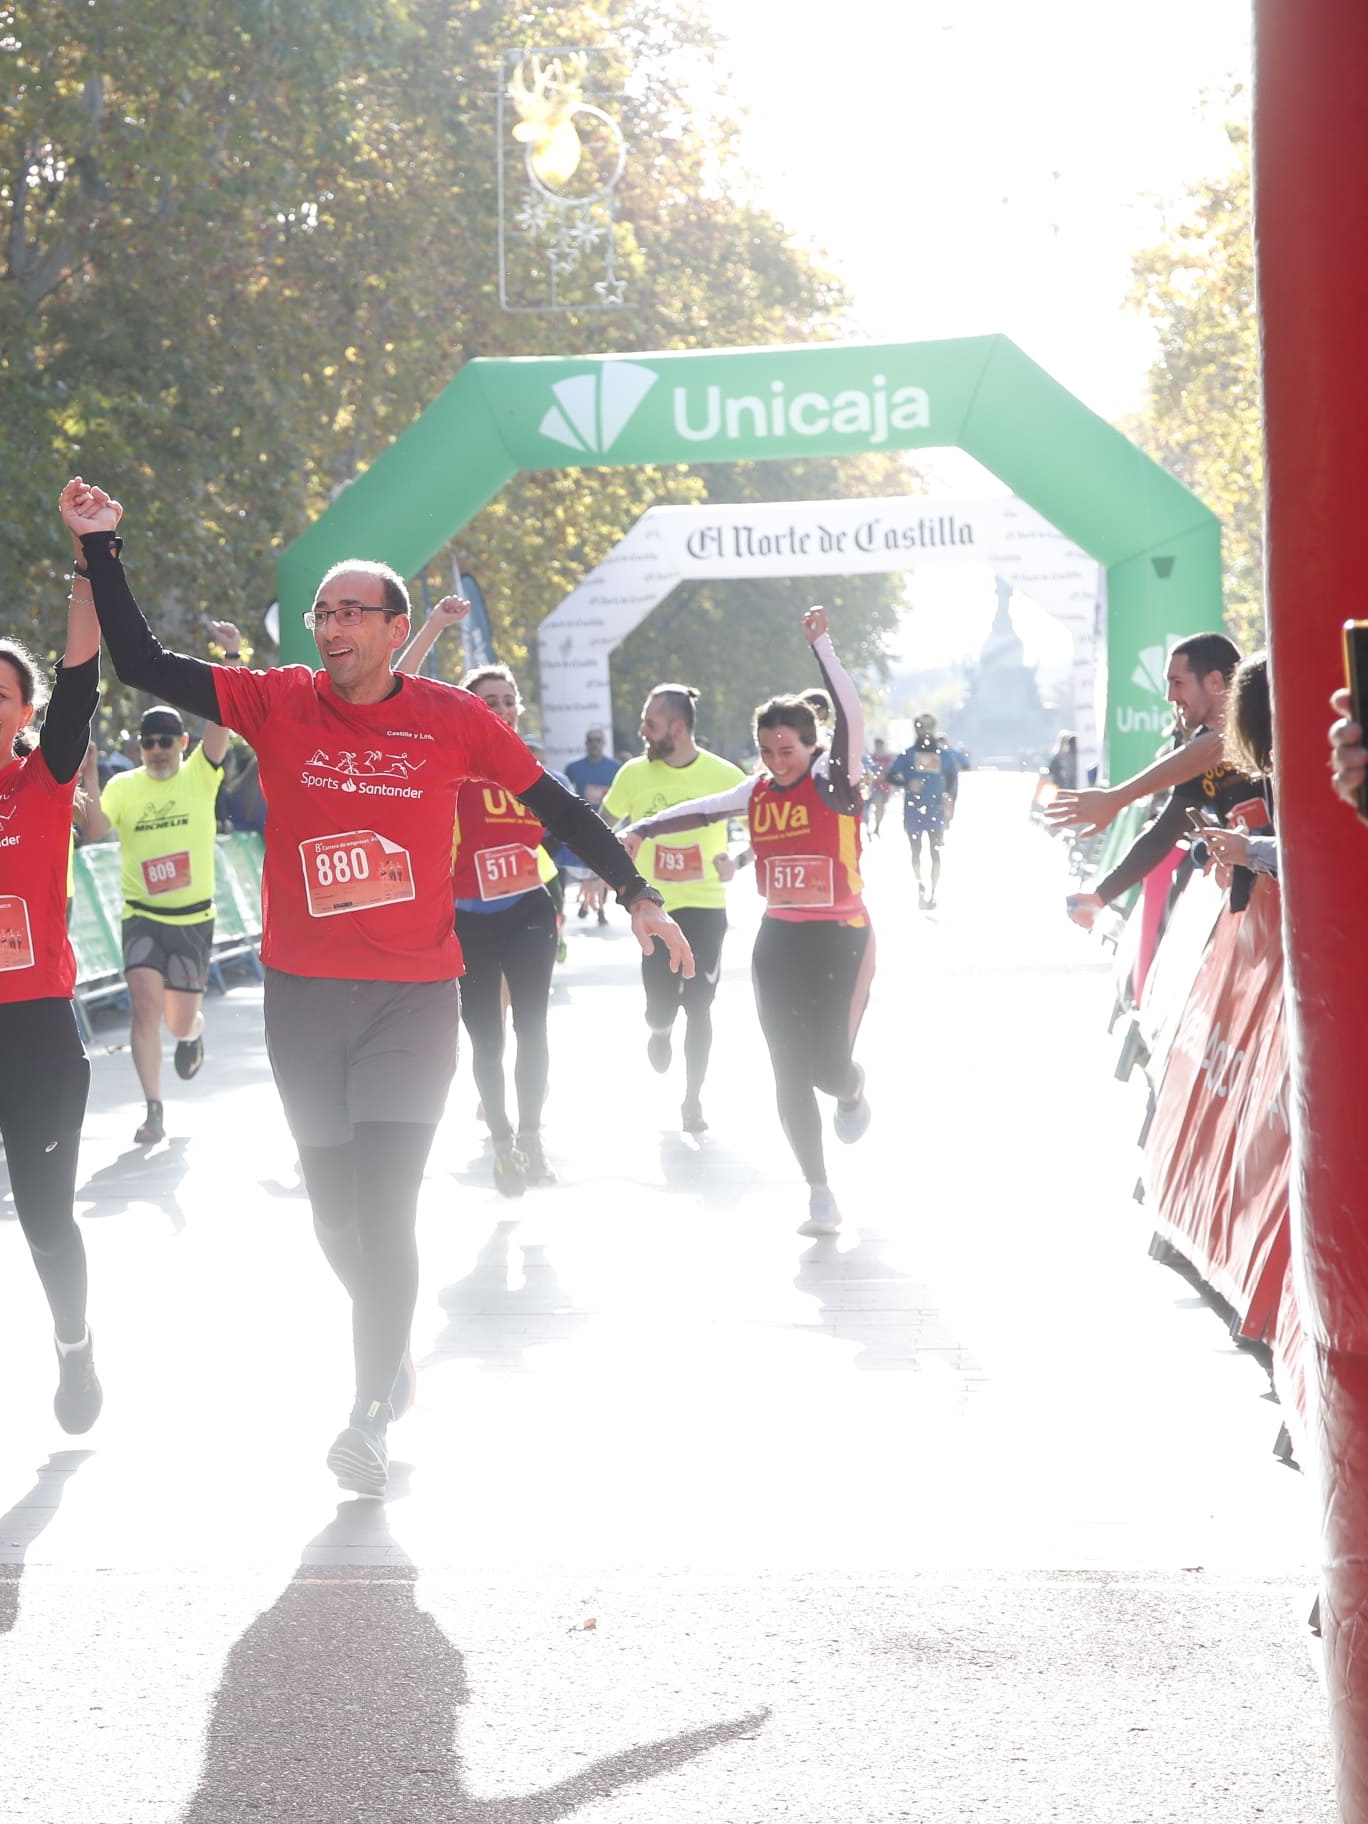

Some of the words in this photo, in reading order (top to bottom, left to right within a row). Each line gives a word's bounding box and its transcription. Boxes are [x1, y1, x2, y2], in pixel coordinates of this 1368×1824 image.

[673, 373, 930, 444] Unicaja
[686, 525, 725, 560] El
[733, 525, 812, 559] Norte
[818, 524, 849, 554] de
[855, 515, 976, 553] Castilla
[1116, 704, 1175, 733] Unic
[301, 772, 339, 790] Sports
[358, 782, 424, 800] Santander
[482, 788, 526, 817] UV
[753, 801, 809, 833] UVa
[148, 861, 176, 882] 809
[316, 847, 370, 886] 880
[486, 855, 518, 880] 511
[658, 851, 685, 871] 793
[774, 866, 806, 888] 512
